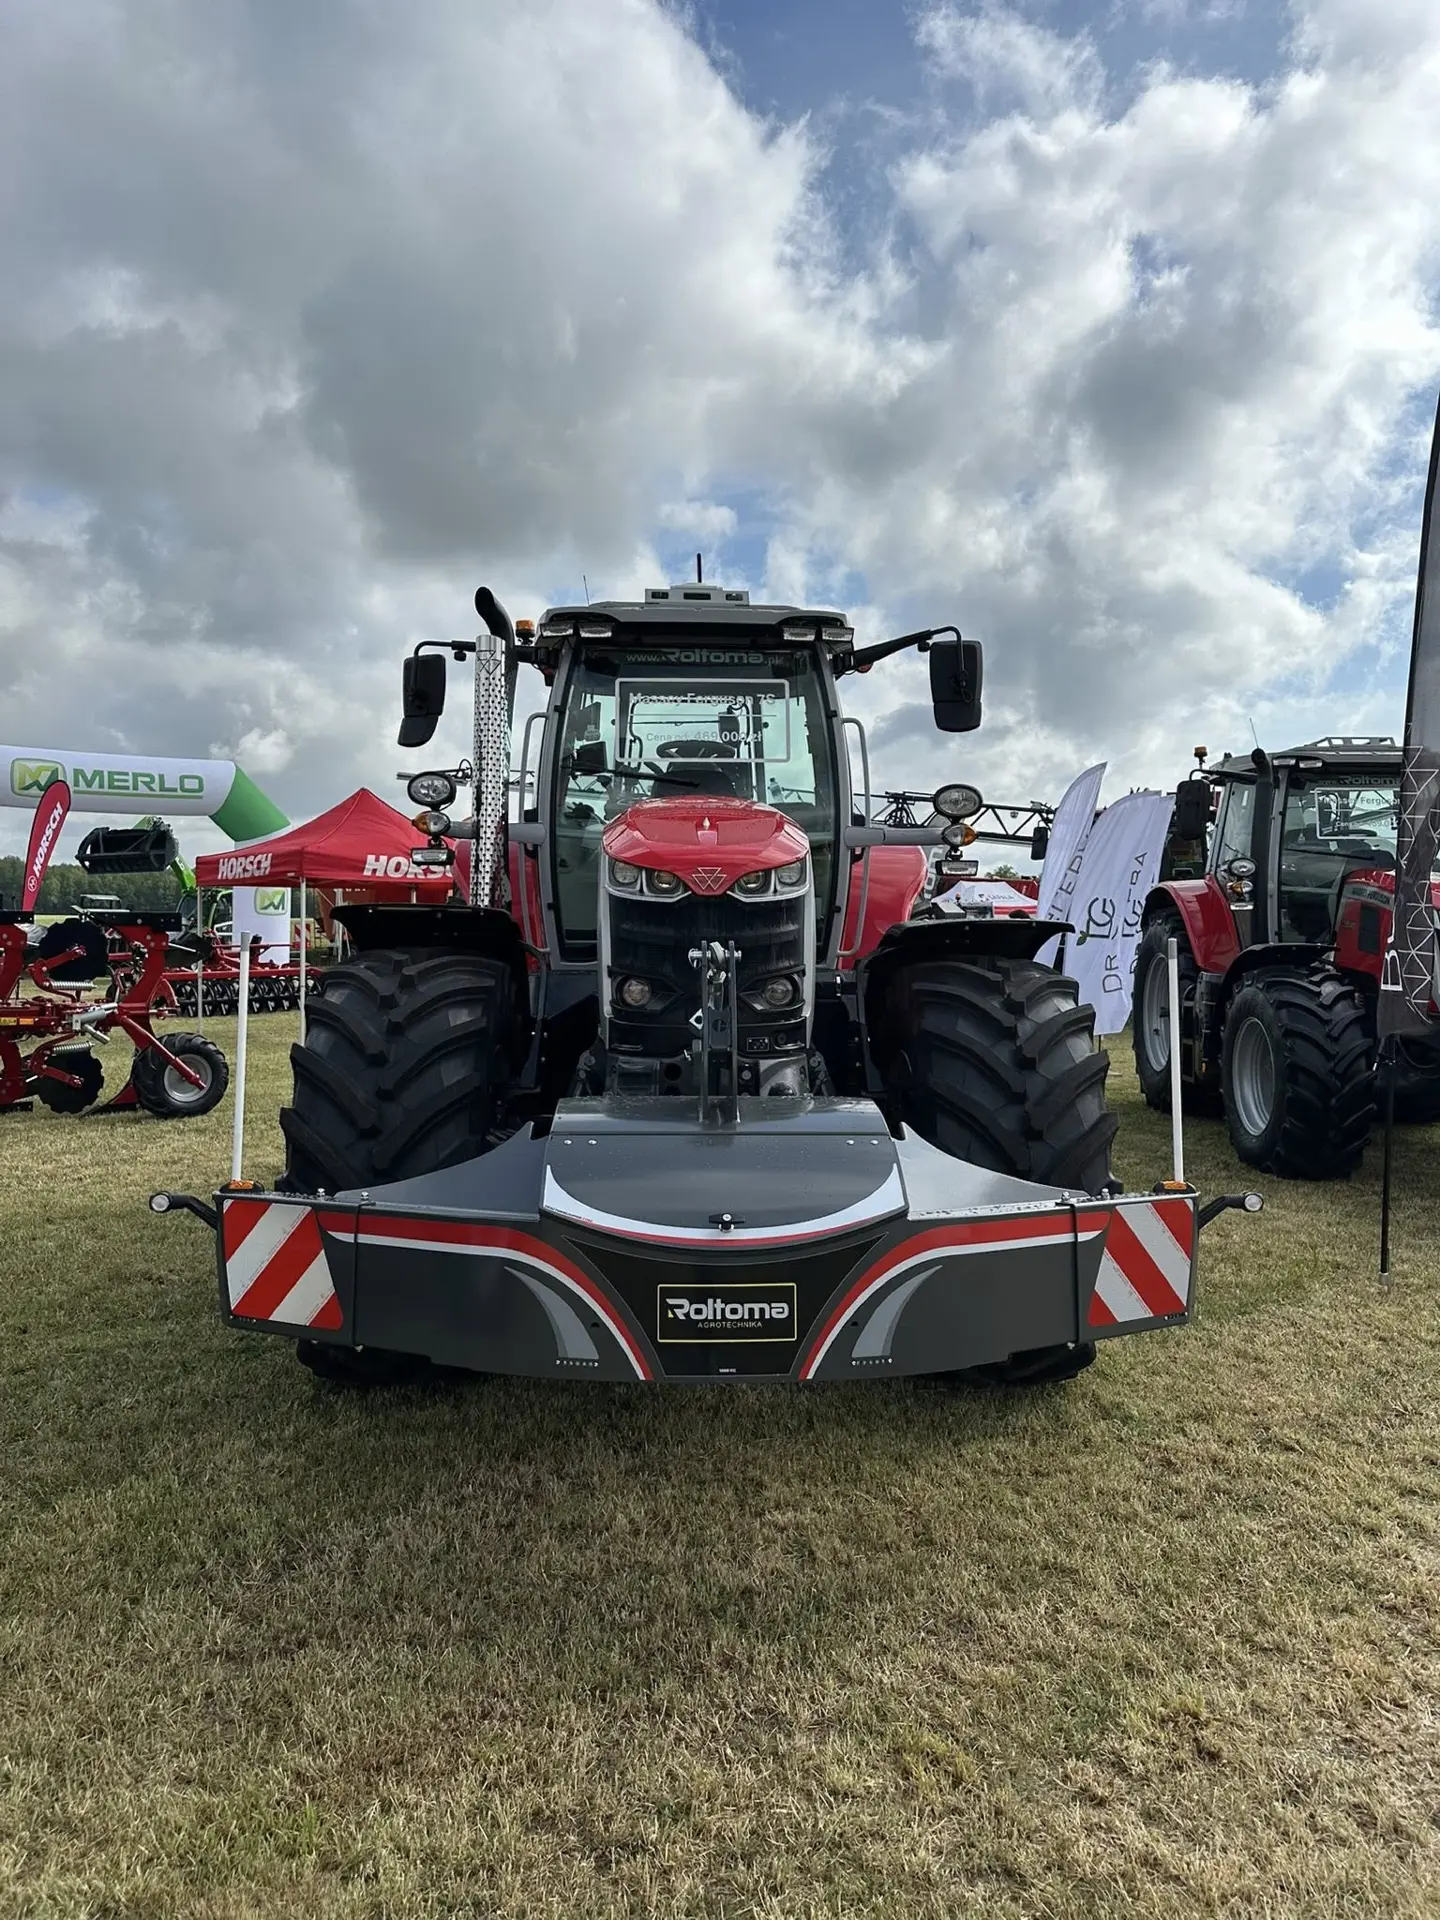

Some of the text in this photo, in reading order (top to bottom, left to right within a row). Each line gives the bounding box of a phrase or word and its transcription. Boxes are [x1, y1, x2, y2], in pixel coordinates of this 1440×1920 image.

[687, 692, 753, 706] Ferguson
[756, 693, 776, 705] 7S
[72, 767, 205, 794] MERLO
[33, 802, 64, 878] HORSCH
[217, 852, 273, 880] HORSCH
[1102, 954, 1123, 994] DR
[665, 1298, 790, 1320] Roltoma
[697, 1321, 763, 1329] AGROTECHNIKA
